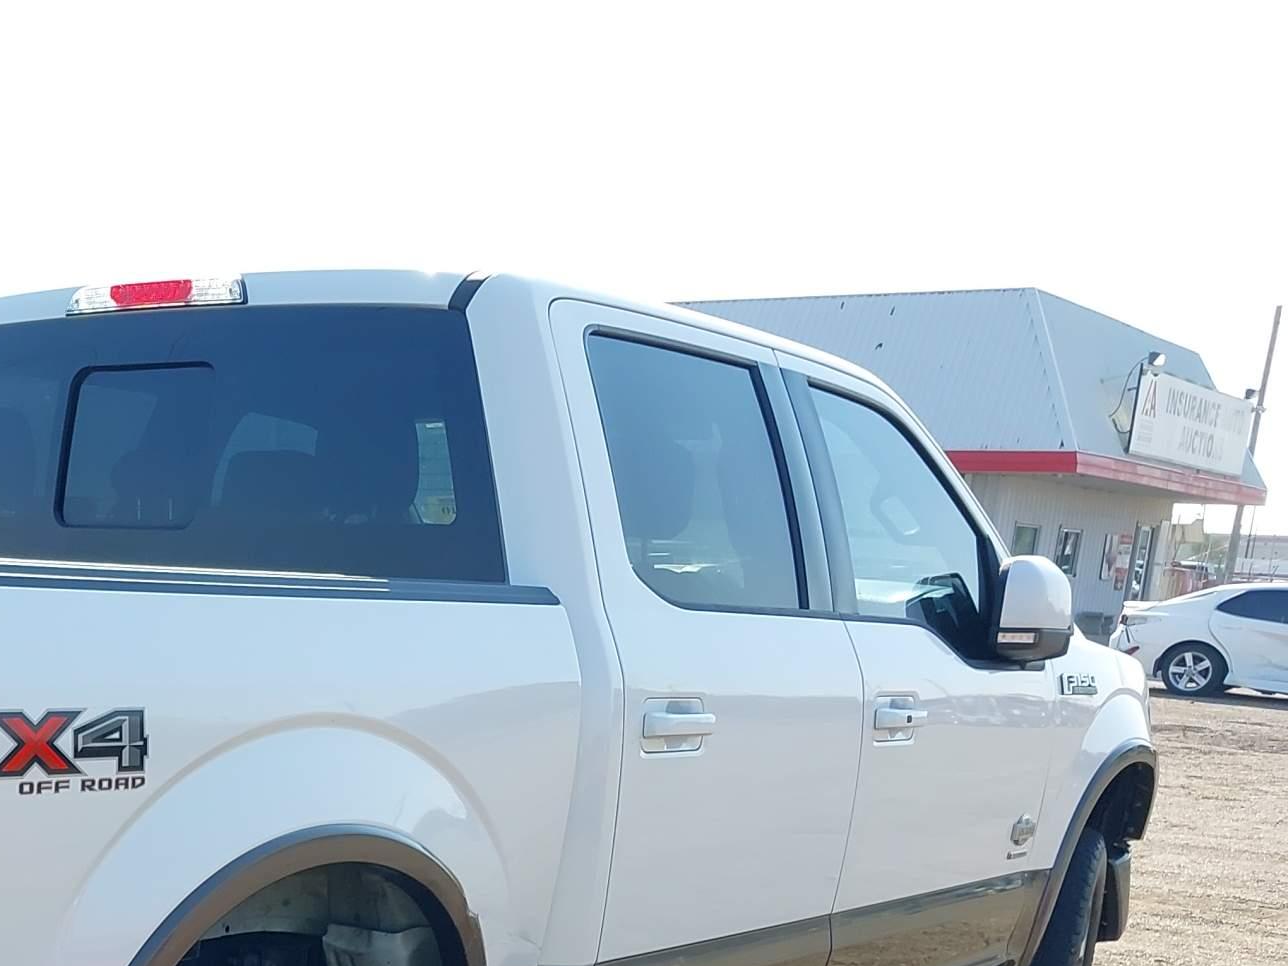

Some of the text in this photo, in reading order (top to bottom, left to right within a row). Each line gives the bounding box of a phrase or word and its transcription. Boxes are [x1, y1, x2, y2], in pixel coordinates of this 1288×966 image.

[1165, 387, 1222, 428] INSURANCE
[1177, 425, 1224, 462] AUCTIO
[18, 775, 147, 795] OFF ROAD
